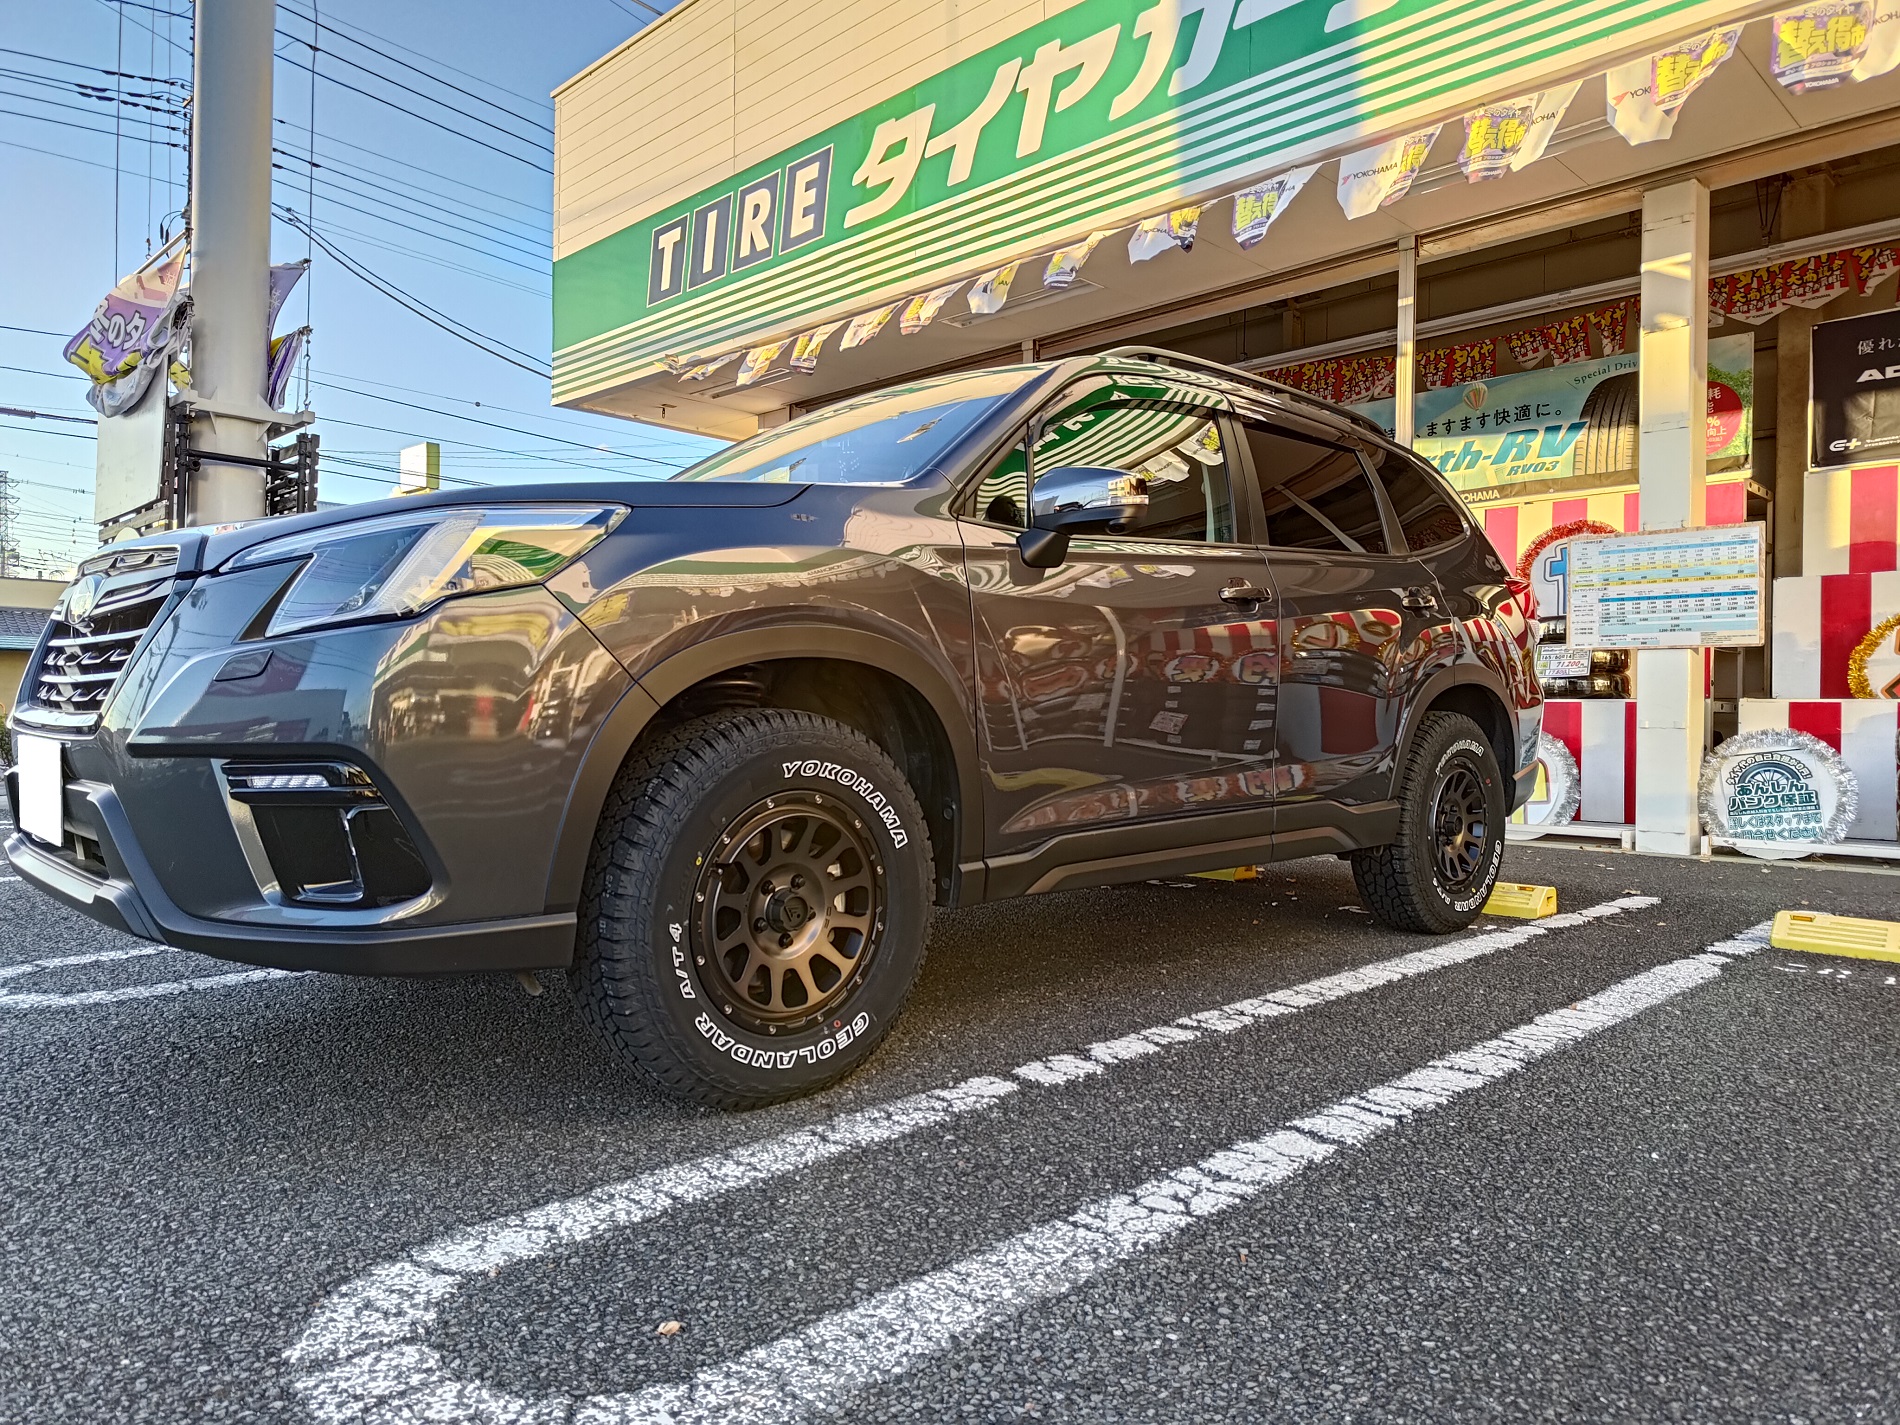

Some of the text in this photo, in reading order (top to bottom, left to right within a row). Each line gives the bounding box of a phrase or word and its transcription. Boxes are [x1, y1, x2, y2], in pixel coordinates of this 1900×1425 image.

[1805, 77, 1839, 88] YOKOHAMA
[1352, 162, 1398, 180] YOKOHAMA
[658, 161, 821, 292] TIRE
[1453, 343, 1494, 367] タイヤ
[1857, 337, 1900, 356] 優れ
[1302, 360, 1338, 380] タイヤ
[1573, 364, 1611, 385] Special
[1506, 460, 1560, 477] RV03
[1435, 739, 1485, 776] YOKOHAMA
[1735, 780, 1806, 797] あんしん
[782, 759, 909, 850] YOKOHAMA
[1728, 791, 1816, 811] パンク保証
[1729, 811, 1822, 831] 詳しくはスタッフまで
[1454, 839, 1502, 912] GEOLANDAR
[668, 922, 870, 1070] GEOLANDAR A/T4
